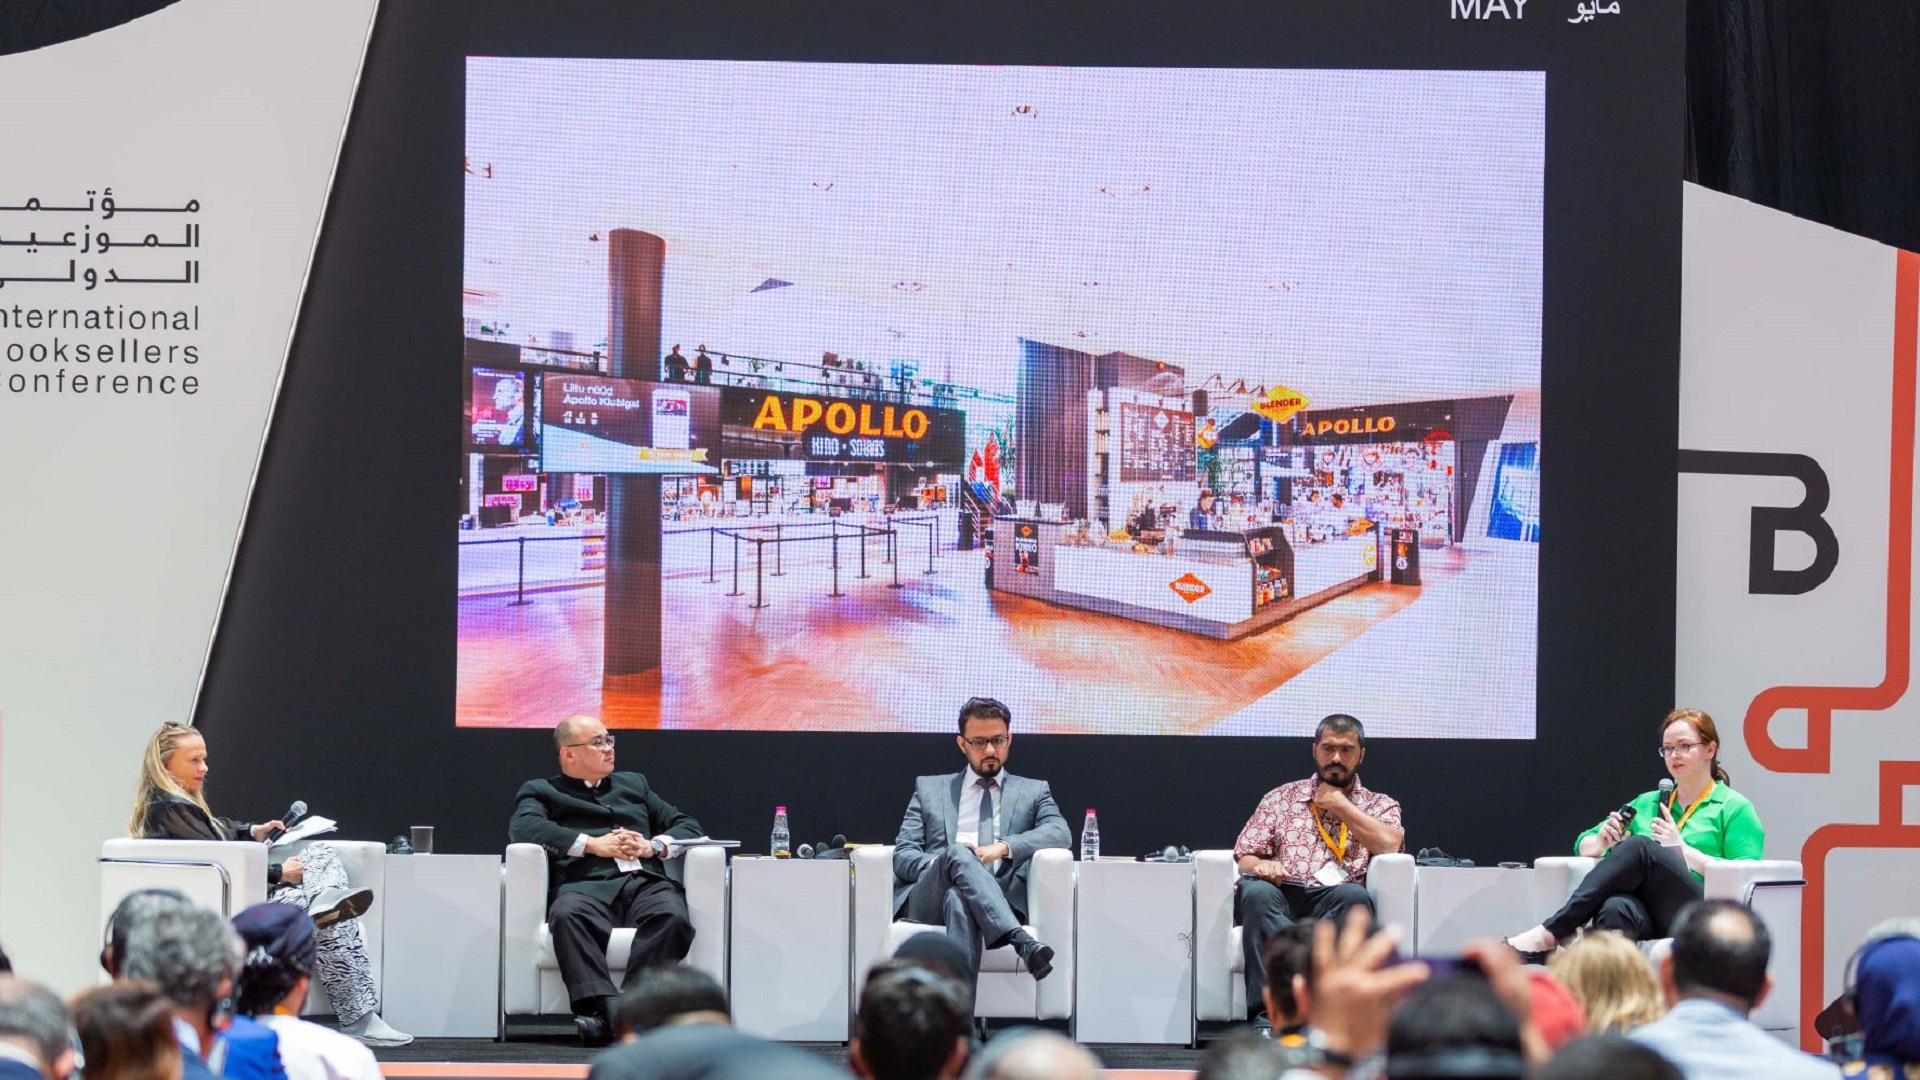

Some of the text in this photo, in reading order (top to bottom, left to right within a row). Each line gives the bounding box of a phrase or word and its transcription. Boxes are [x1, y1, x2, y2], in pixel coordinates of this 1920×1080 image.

[1451, 0, 1528, 20] MAY
[1568, 0, 1621, 24] مايو
[0, 187, 200, 220] مؤتم
[0, 223, 200, 254] الموزعي
[0, 259, 199, 290] الدول
[0, 304, 199, 330] nternational
[6, 337, 199, 364] ooksellers
[0, 368, 199, 394] onference
[1260, 397, 1301, 409] BLENDER
[752, 395, 929, 440] APOLLO
[1301, 416, 1396, 436] APOLLO
